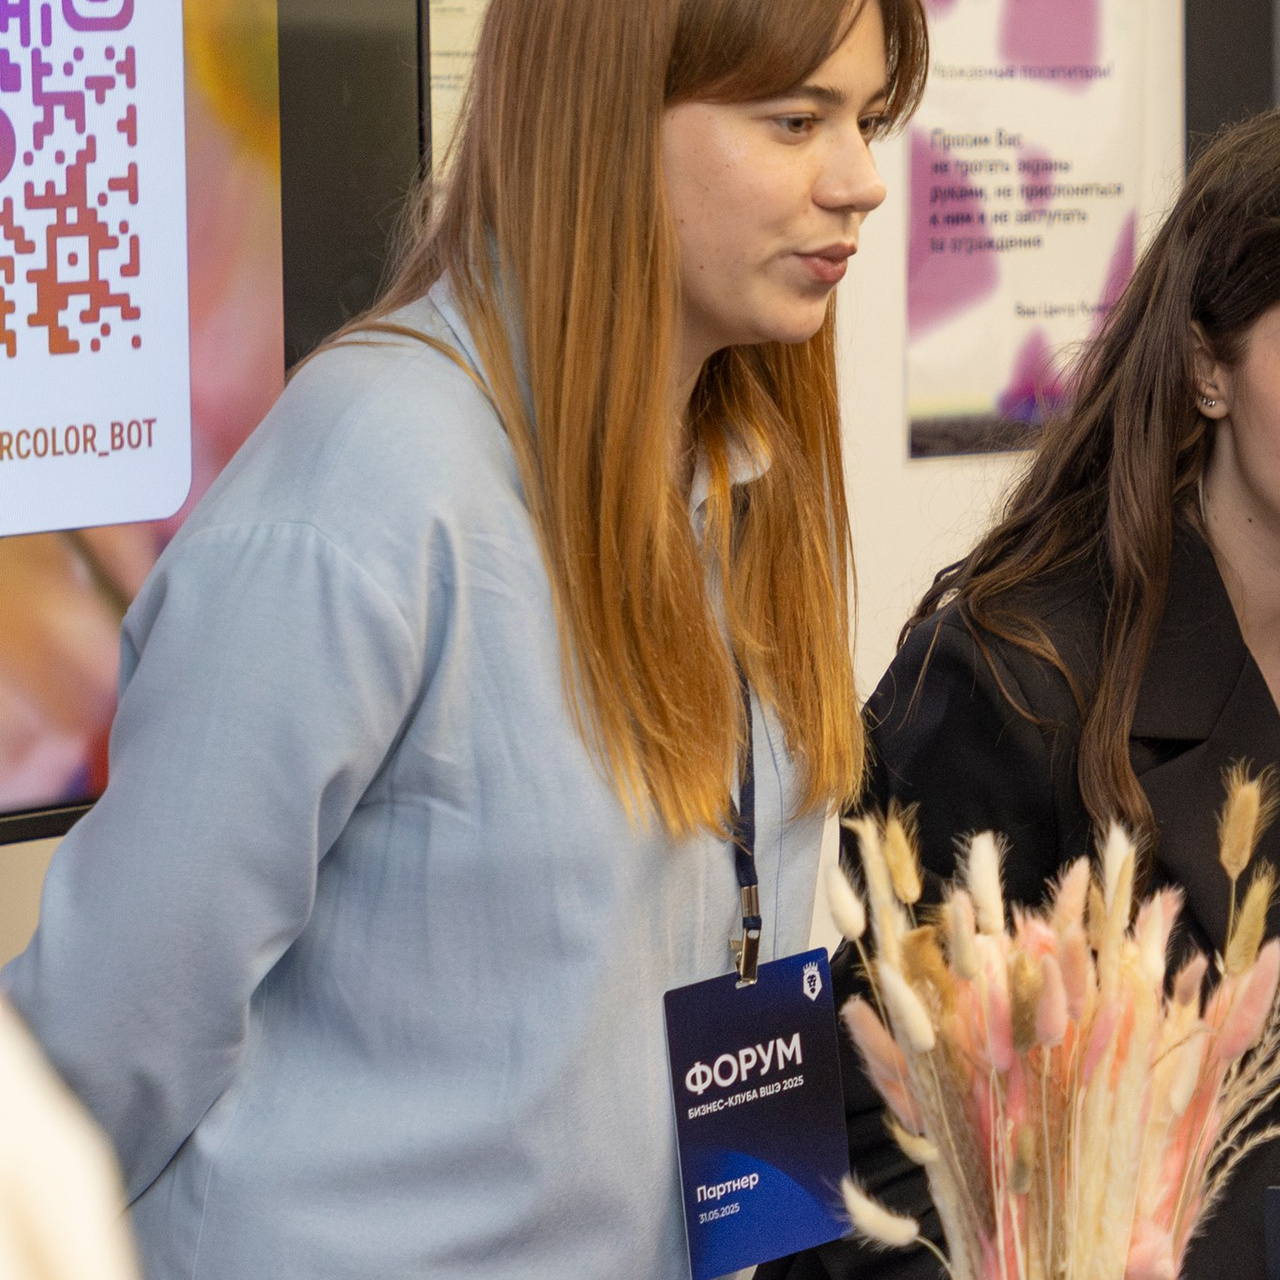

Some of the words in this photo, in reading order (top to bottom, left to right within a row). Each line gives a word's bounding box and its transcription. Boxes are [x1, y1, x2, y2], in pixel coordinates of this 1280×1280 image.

[685, 1032, 803, 1096] ФОРУМ
[688, 1089, 759, 1120] БИЗНЕС-КЛУБА
[759, 1081, 781, 1099] ВШЭ
[782, 1074, 805, 1092] 2025
[696, 1172, 760, 1203] Партнер
[698, 1202, 741, 1225] 31.05.2025
